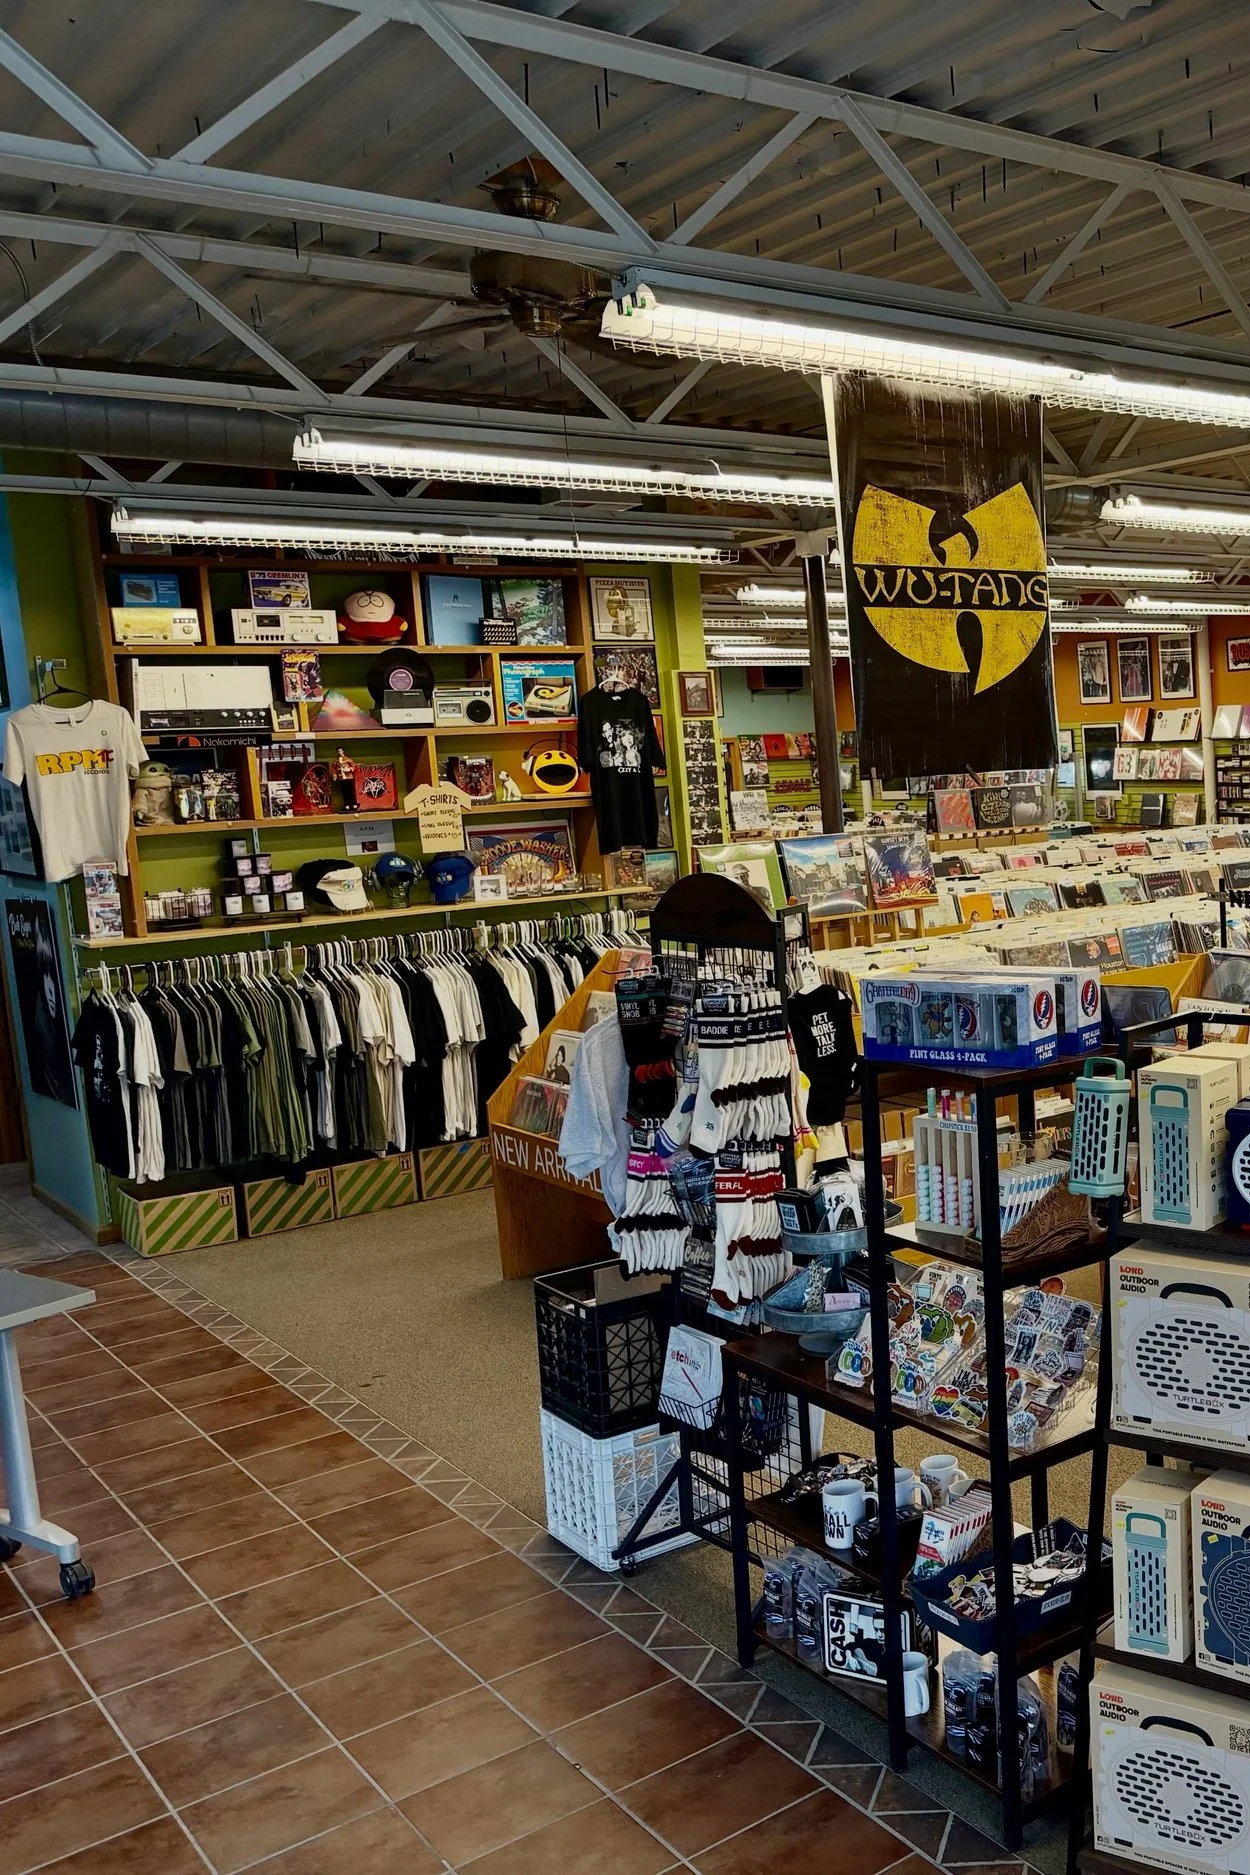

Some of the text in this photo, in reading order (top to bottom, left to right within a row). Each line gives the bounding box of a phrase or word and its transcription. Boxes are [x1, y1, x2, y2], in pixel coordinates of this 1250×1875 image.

[855, 566, 1048, 606] WU-TANG
[203, 737, 257, 747] Nakamichi
[35, 750, 107, 776] RPM
[420, 794, 460, 807] T-SHIRTS
[620, 1002, 640, 1011] VINYL
[621, 1010, 641, 1018] SNOB
[812, 1011, 828, 1026] PET
[701, 1026, 729, 1034] BADDIE
[815, 1032, 836, 1047] TALK
[817, 1043, 837, 1058] LESS.
[910, 1050, 988, 1063] PINT GLASS 4-PACK
[493, 1131, 604, 1194] NEW ARRAL
[715, 1181, 744, 1190] FERAL
[1119, 1274, 1160, 1287] OUTDOOR
[1119, 1283, 1146, 1294] AUDIO
[1172, 1393, 1224, 1408] TURTLEBOX
[1162, 1429, 1183, 1437] PORTABLE
[1183, 1432, 1202, 1440] SPEAKER
[1217, 1438, 1246, 1448] WATERPROOF
[1201, 1508, 1241, 1525] OUTDOOR
[1201, 1518, 1228, 1531] AUDIO
[830, 1600, 847, 1667] CASH
[1099, 1702, 1140, 1718] OUTDOOR
[1099, 1710, 1126, 1722] AUDIO
[1154, 1822, 1206, 1842] TURTLEBOX
